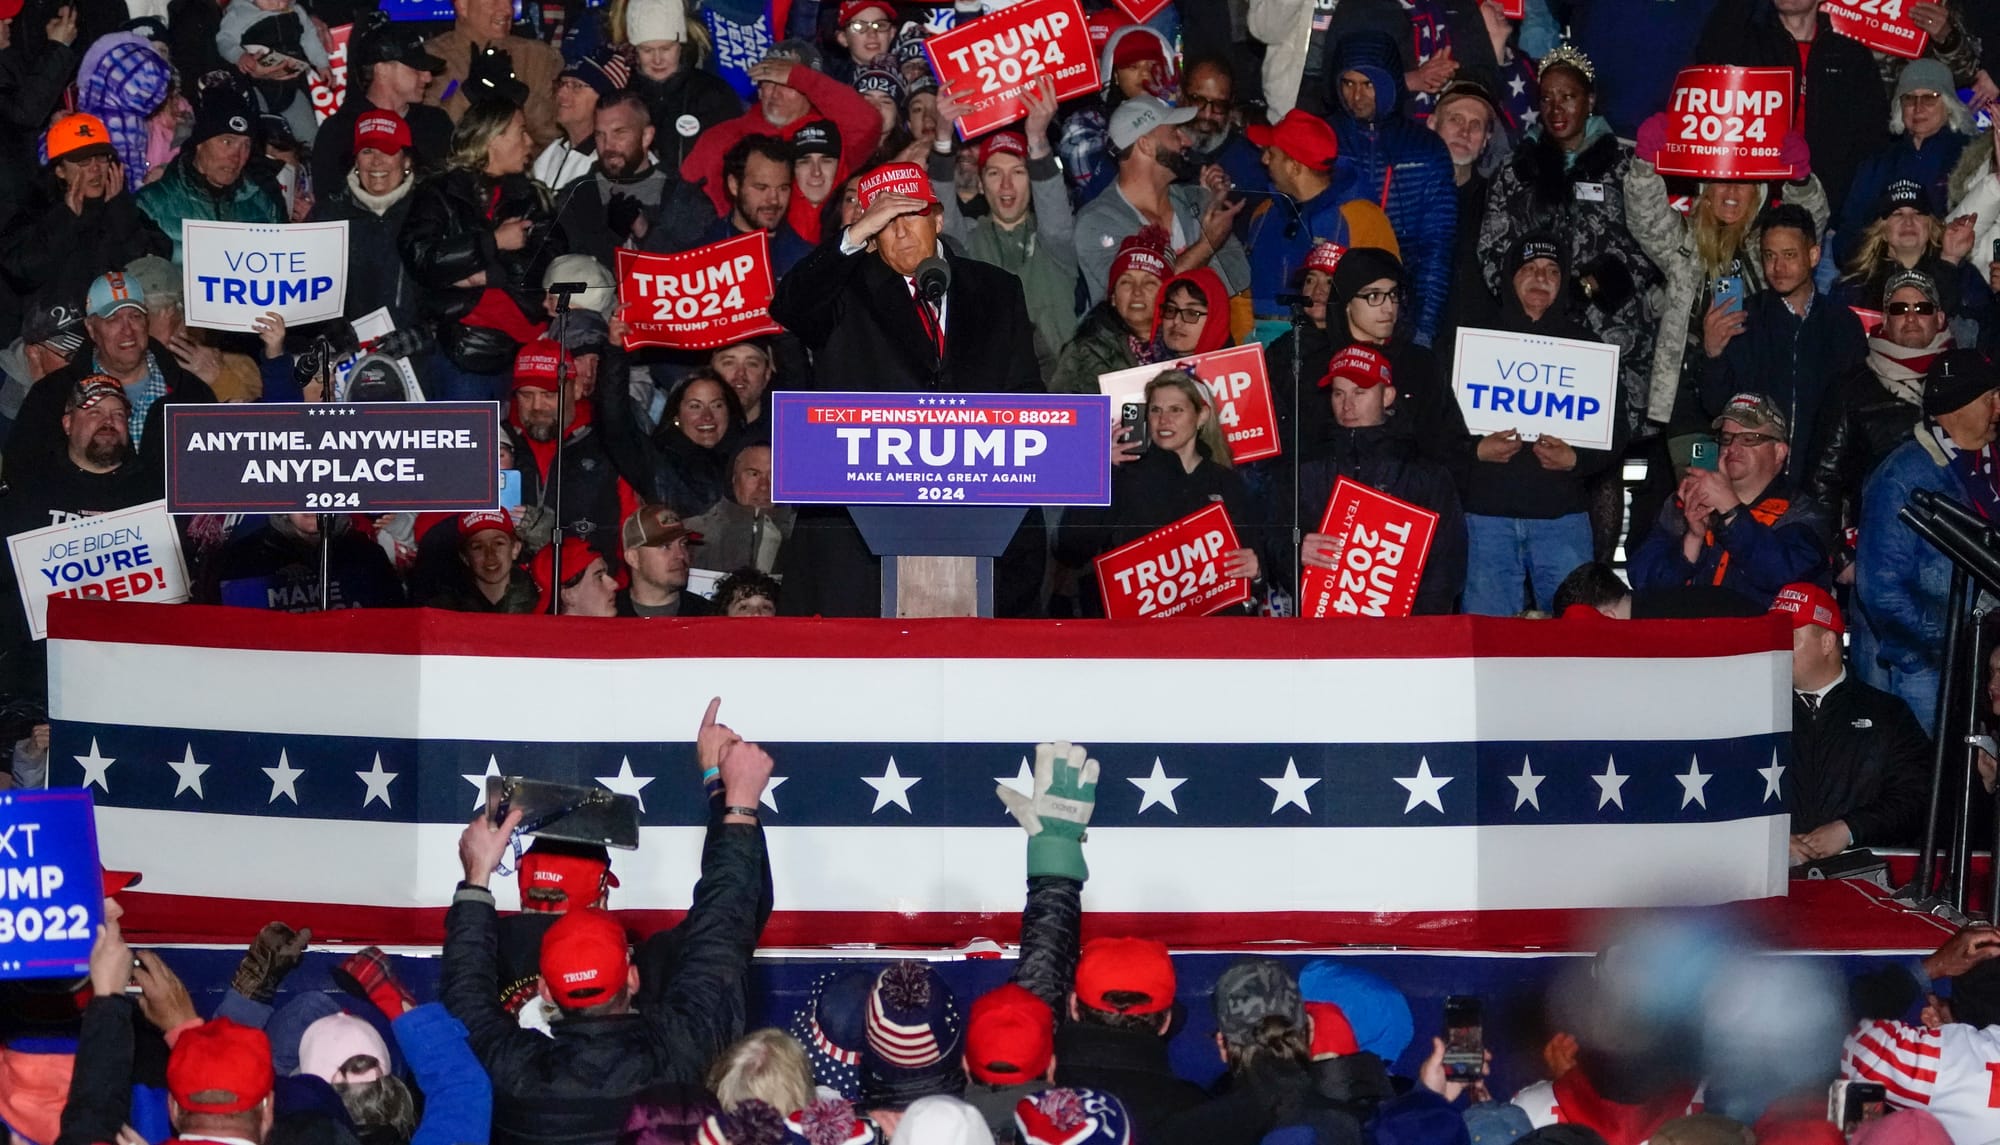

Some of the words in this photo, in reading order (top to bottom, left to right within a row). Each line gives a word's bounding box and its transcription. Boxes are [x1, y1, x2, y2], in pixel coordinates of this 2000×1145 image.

[1825, 2, 1862, 21] TRUMP
[1865, 17, 1879, 28] TO
[1881, 22, 1916, 39] 88022
[948, 11, 1070, 73] TRUMP
[976, 41, 1065, 94] 2024
[857, 76, 898, 98] 2024
[965, 96, 995, 112] EXT
[1056, 63, 1087, 80] 88022
[1674, 87, 1783, 116] TRUMP
[1680, 114, 1766, 143] 2024
[1666, 142, 1687, 153] TEXT
[1690, 144, 1729, 156] TRUMP
[1733, 147, 1748, 157] TO
[861, 174, 881, 193] MAKE
[881, 168, 922, 183] AMERICA
[892, 182, 919, 194] AGAIN
[225, 250, 306, 273] VOTE
[632, 254, 754, 297] TRUMP
[1130, 253, 1164, 269] TRUMP
[198, 276, 333, 306] TRUMP
[652, 285, 745, 320] 2024
[633, 322, 663, 332] TEXT
[667, 322, 709, 332] TRUMP
[712, 317, 728, 328] TO
[731, 307, 767, 323] 88022
[1497, 359, 1576, 388] VOTE
[815, 409, 856, 422] TEXT
[861, 410, 987, 423] PENNSYLVANIA
[993, 410, 1015, 423] TO
[1019, 411, 1070, 424] 88022
[1466, 383, 1600, 421] TRUMP
[187, 432, 312, 451] ANYTIME.
[319, 429, 477, 449] ANYWHERE.
[836, 428, 1047, 466] TRUMP
[1228, 427, 1264, 442] 88022
[241, 458, 424, 483] ANYPLACE.
[847, 472, 882, 482] MAKE
[886, 473, 943, 483] AMERICA
[947, 473, 988, 483] GREAT
[992, 473, 1036, 483] AGAIN!
[305, 492, 360, 507] 2024
[917, 487, 965, 500] 2024
[1343, 499, 1360, 529] TEXT
[42, 540, 80, 562] JOE
[84, 526, 143, 553] BIDEN,
[40, 544, 152, 587] YOU'RE
[1114, 530, 1225, 595] TRUMP
[1333, 524, 1379, 615] 2024
[1360, 521, 1412, 617] TRUM
[1136, 562, 1218, 616] 2024
[1190, 594, 1203, 606] TO
[1205, 579, 1237, 599] 88022
[1323, 574, 1336, 589] TO
[534, 871, 563, 882] TRUMP
[563, 969, 598, 984] TRUMP
